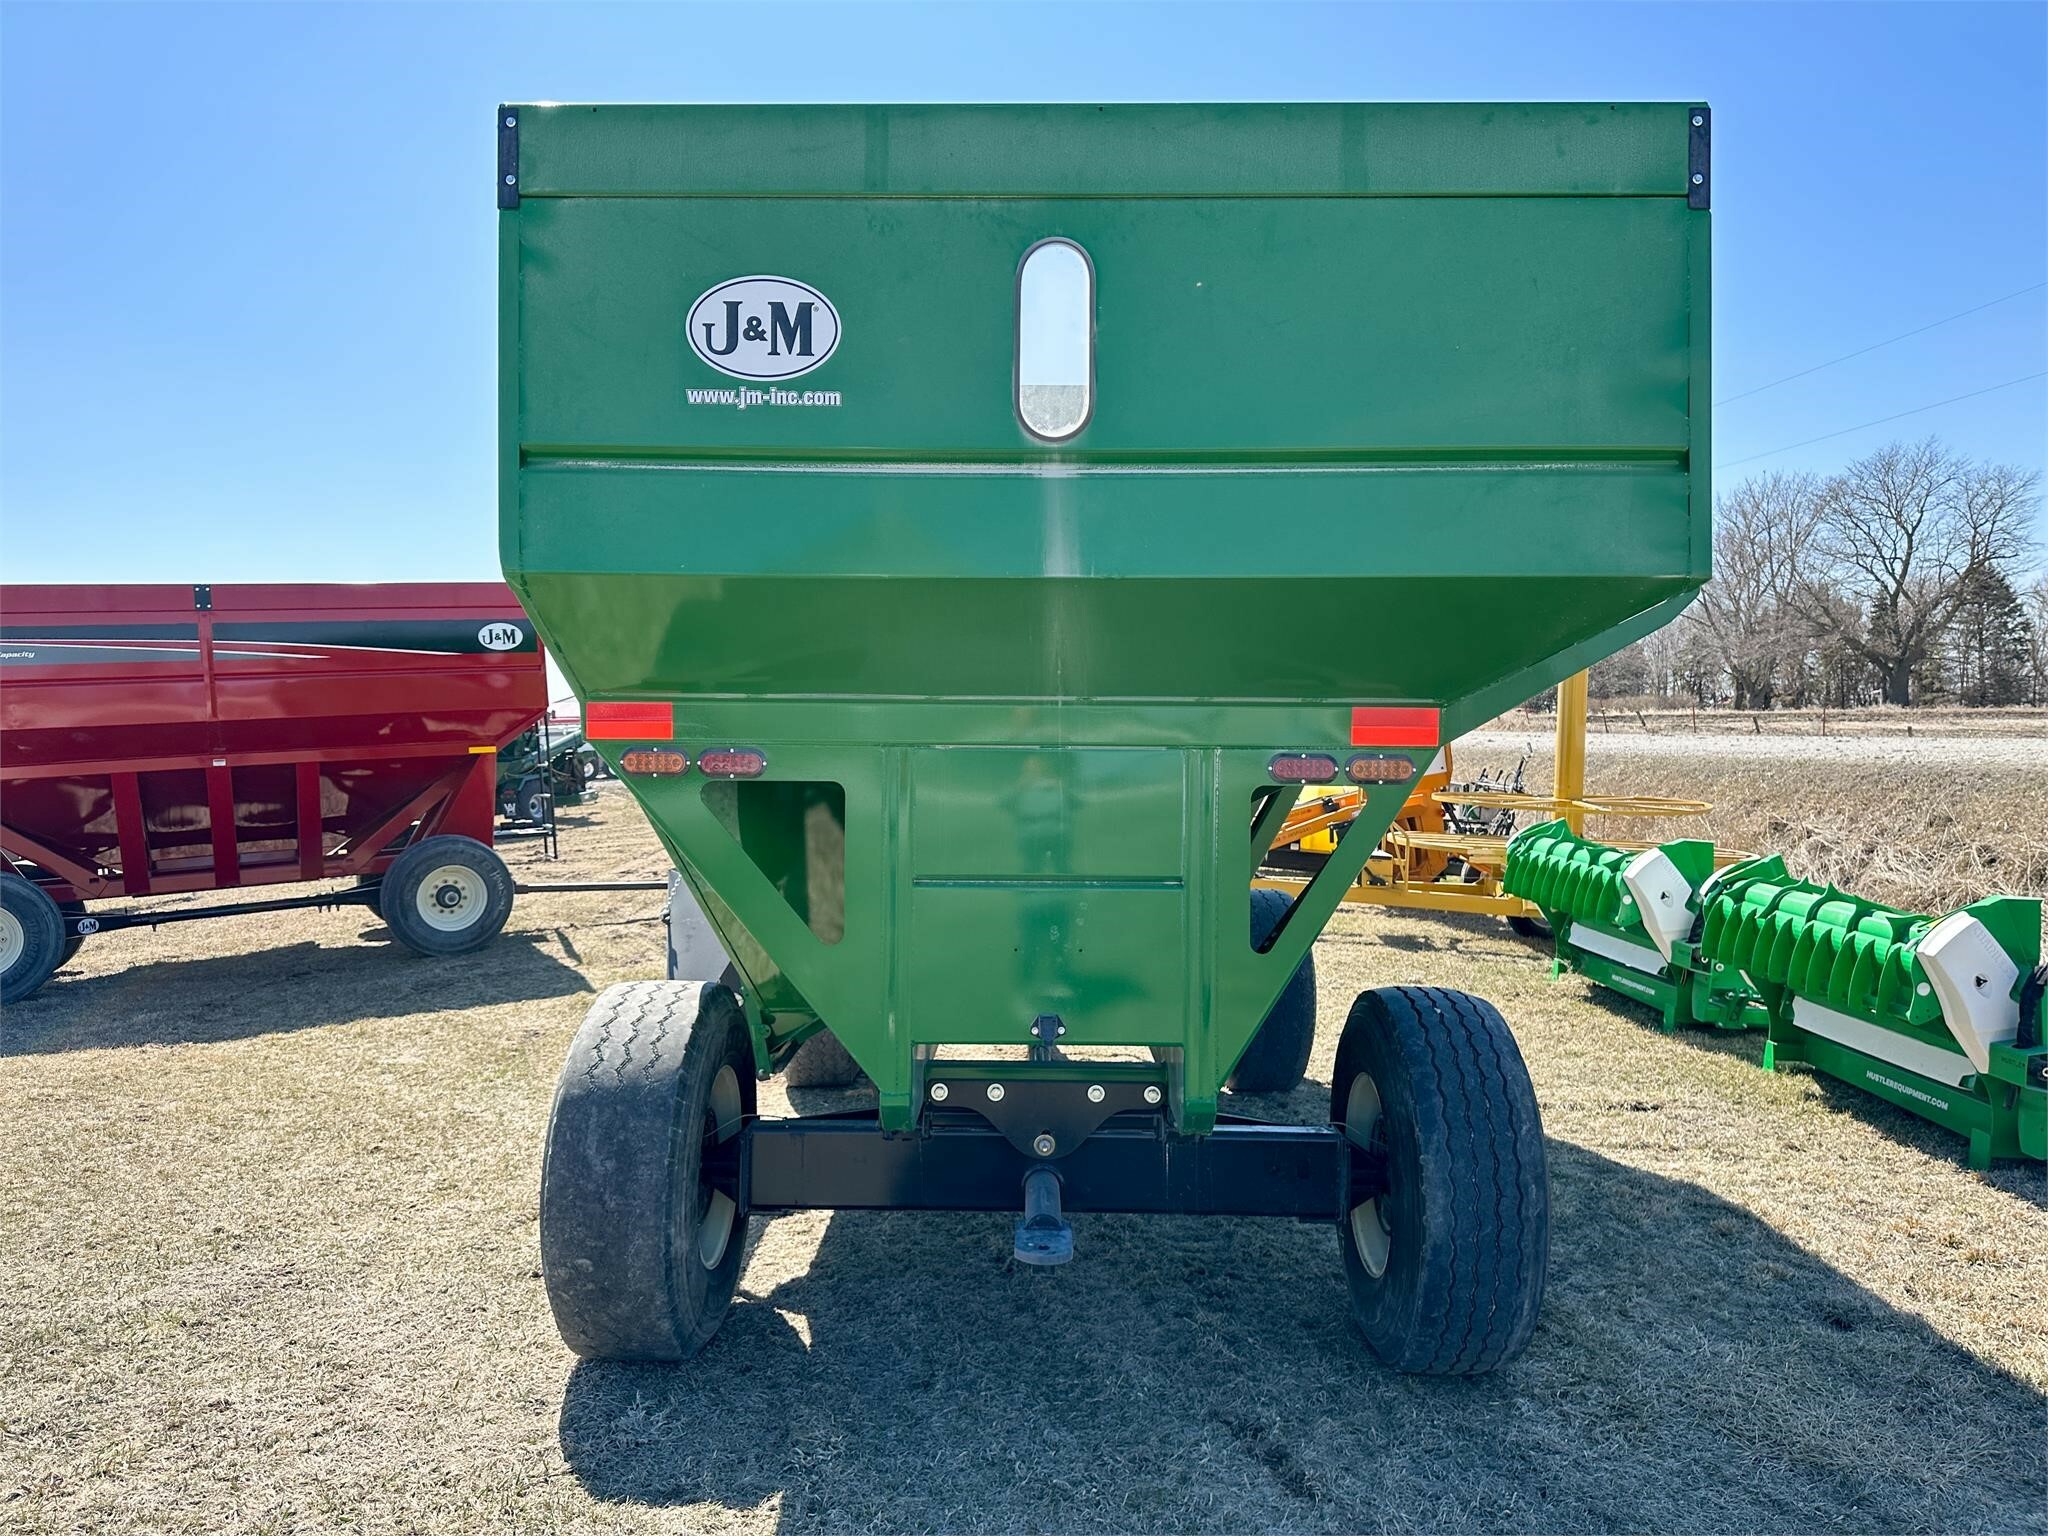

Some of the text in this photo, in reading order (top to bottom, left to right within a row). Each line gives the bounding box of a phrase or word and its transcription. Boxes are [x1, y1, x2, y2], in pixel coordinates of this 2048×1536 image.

[702, 300, 815, 357] J&M
[686, 387, 842, 410] www.jm-inc.com
[482, 628, 517, 645] J&M
[79, 920, 97, 932] J&M
[1866, 1070, 1949, 1111] HUSTLEREQUIPMENT.COM
